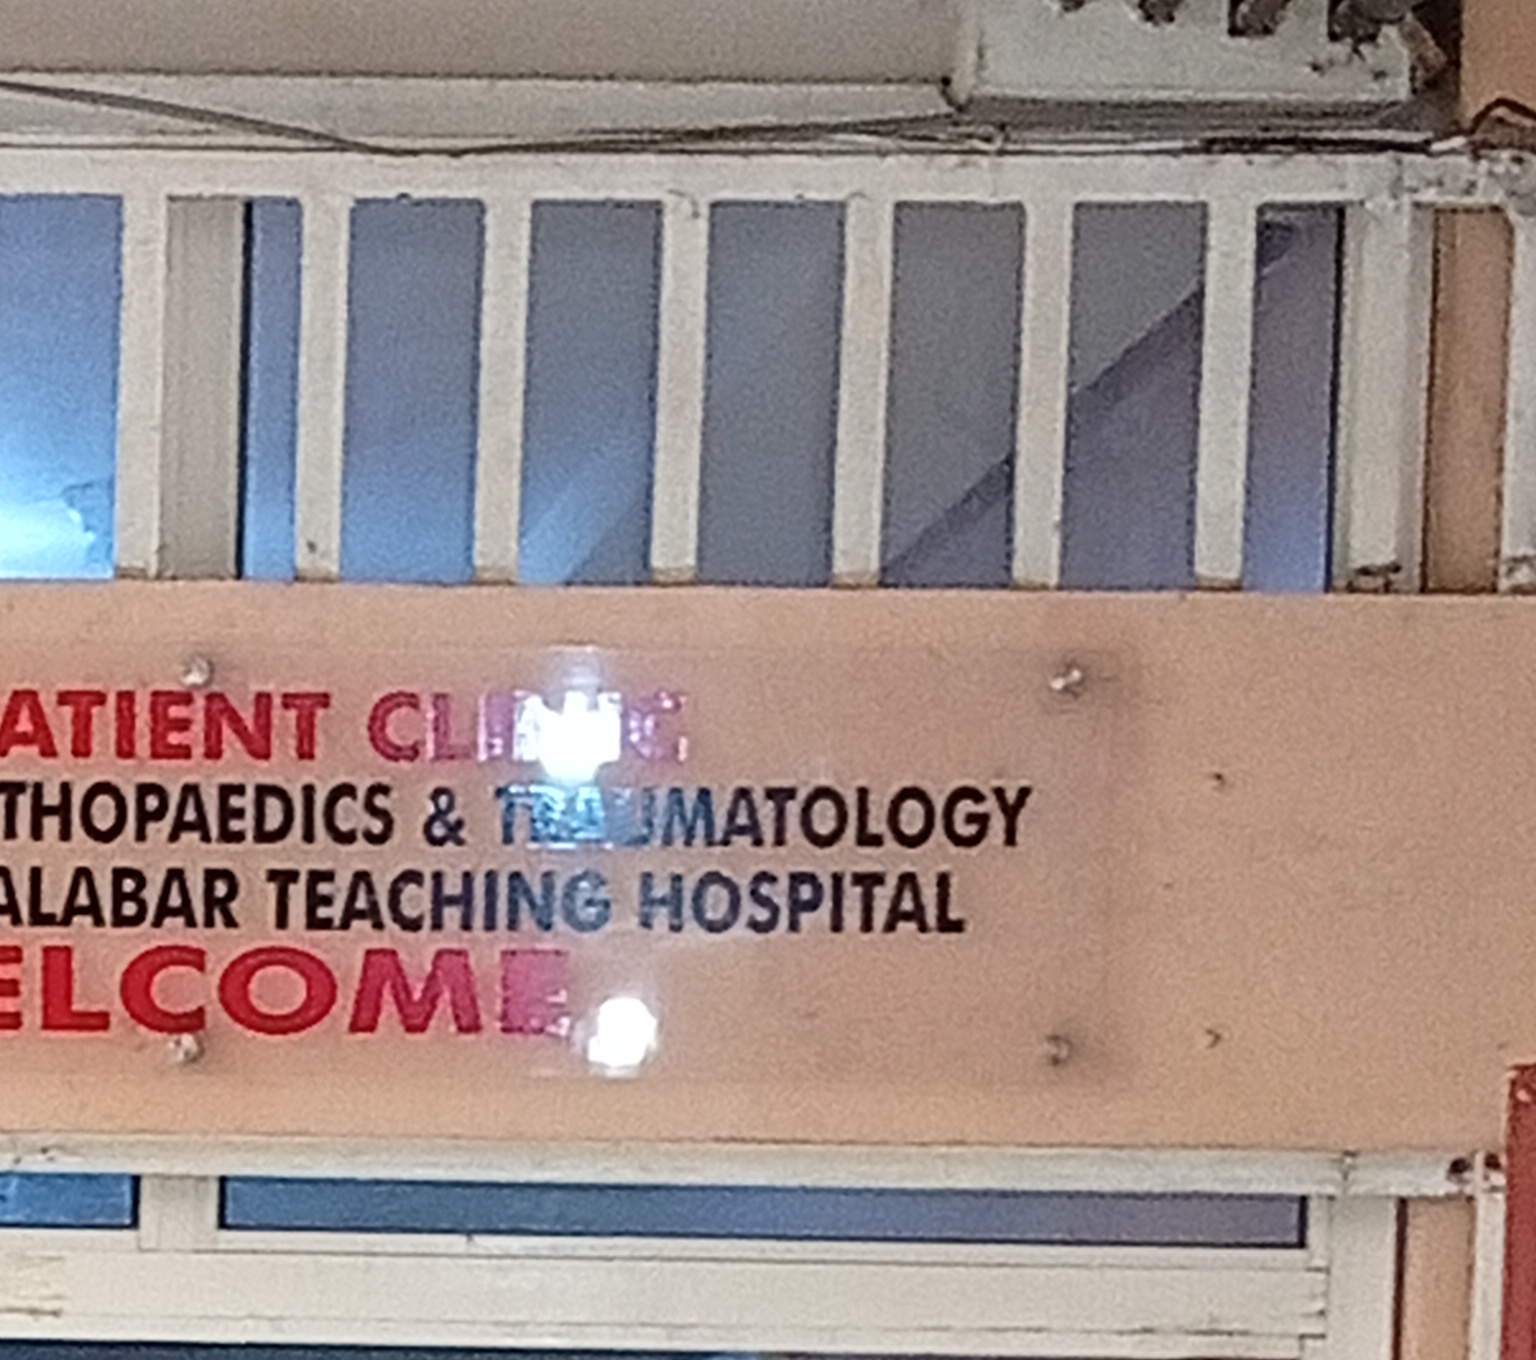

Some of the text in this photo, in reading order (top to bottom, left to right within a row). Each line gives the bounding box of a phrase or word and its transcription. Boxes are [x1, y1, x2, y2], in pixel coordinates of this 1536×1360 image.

[367, 690, 689, 763] CLIC
[422, 787, 466, 846] &
[267, 867, 611, 932] TEACHING
[639, 870, 966, 933] HOSPITAL
